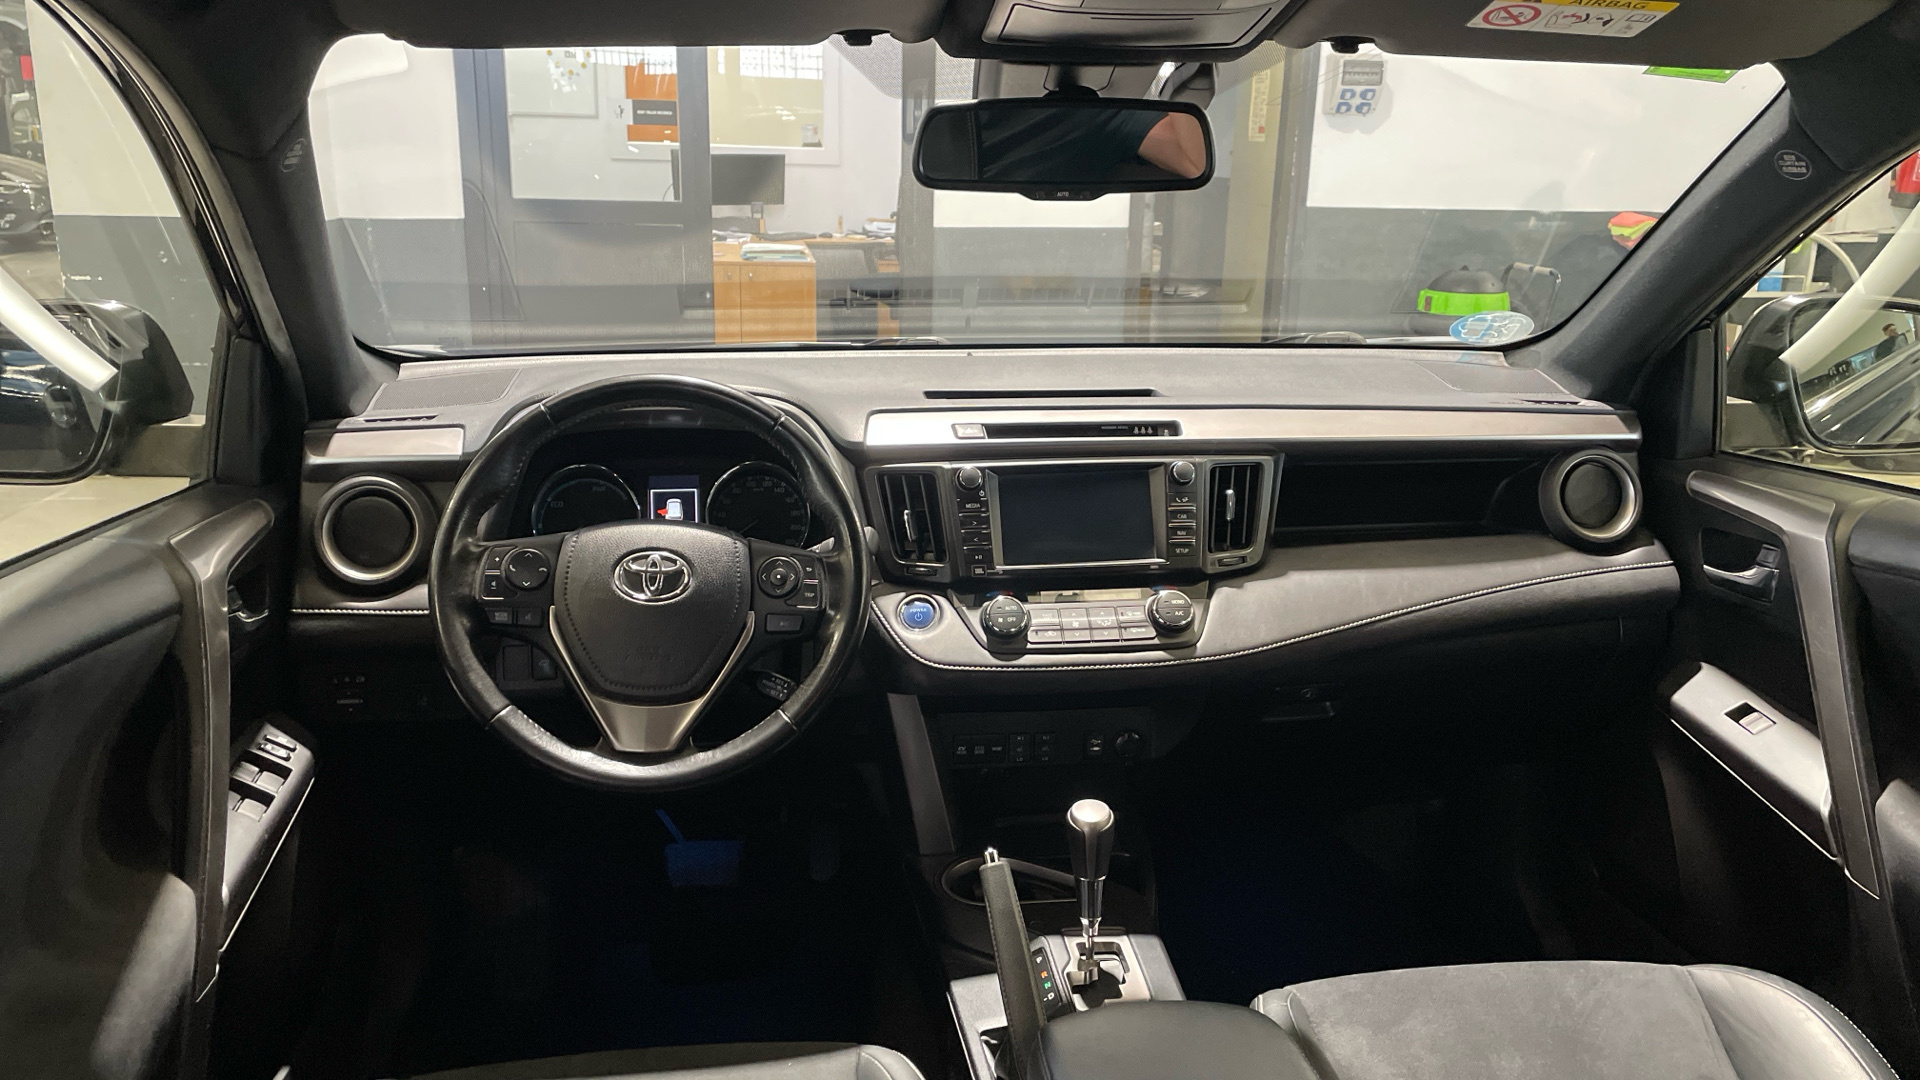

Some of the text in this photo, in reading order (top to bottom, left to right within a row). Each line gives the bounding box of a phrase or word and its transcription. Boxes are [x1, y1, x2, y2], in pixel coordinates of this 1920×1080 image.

[1568, 0, 1648, 10] AIRBAG
[1036, 956, 1043, 964] P
[1040, 970, 1048, 979] R
[1044, 981, 1051, 990] N
